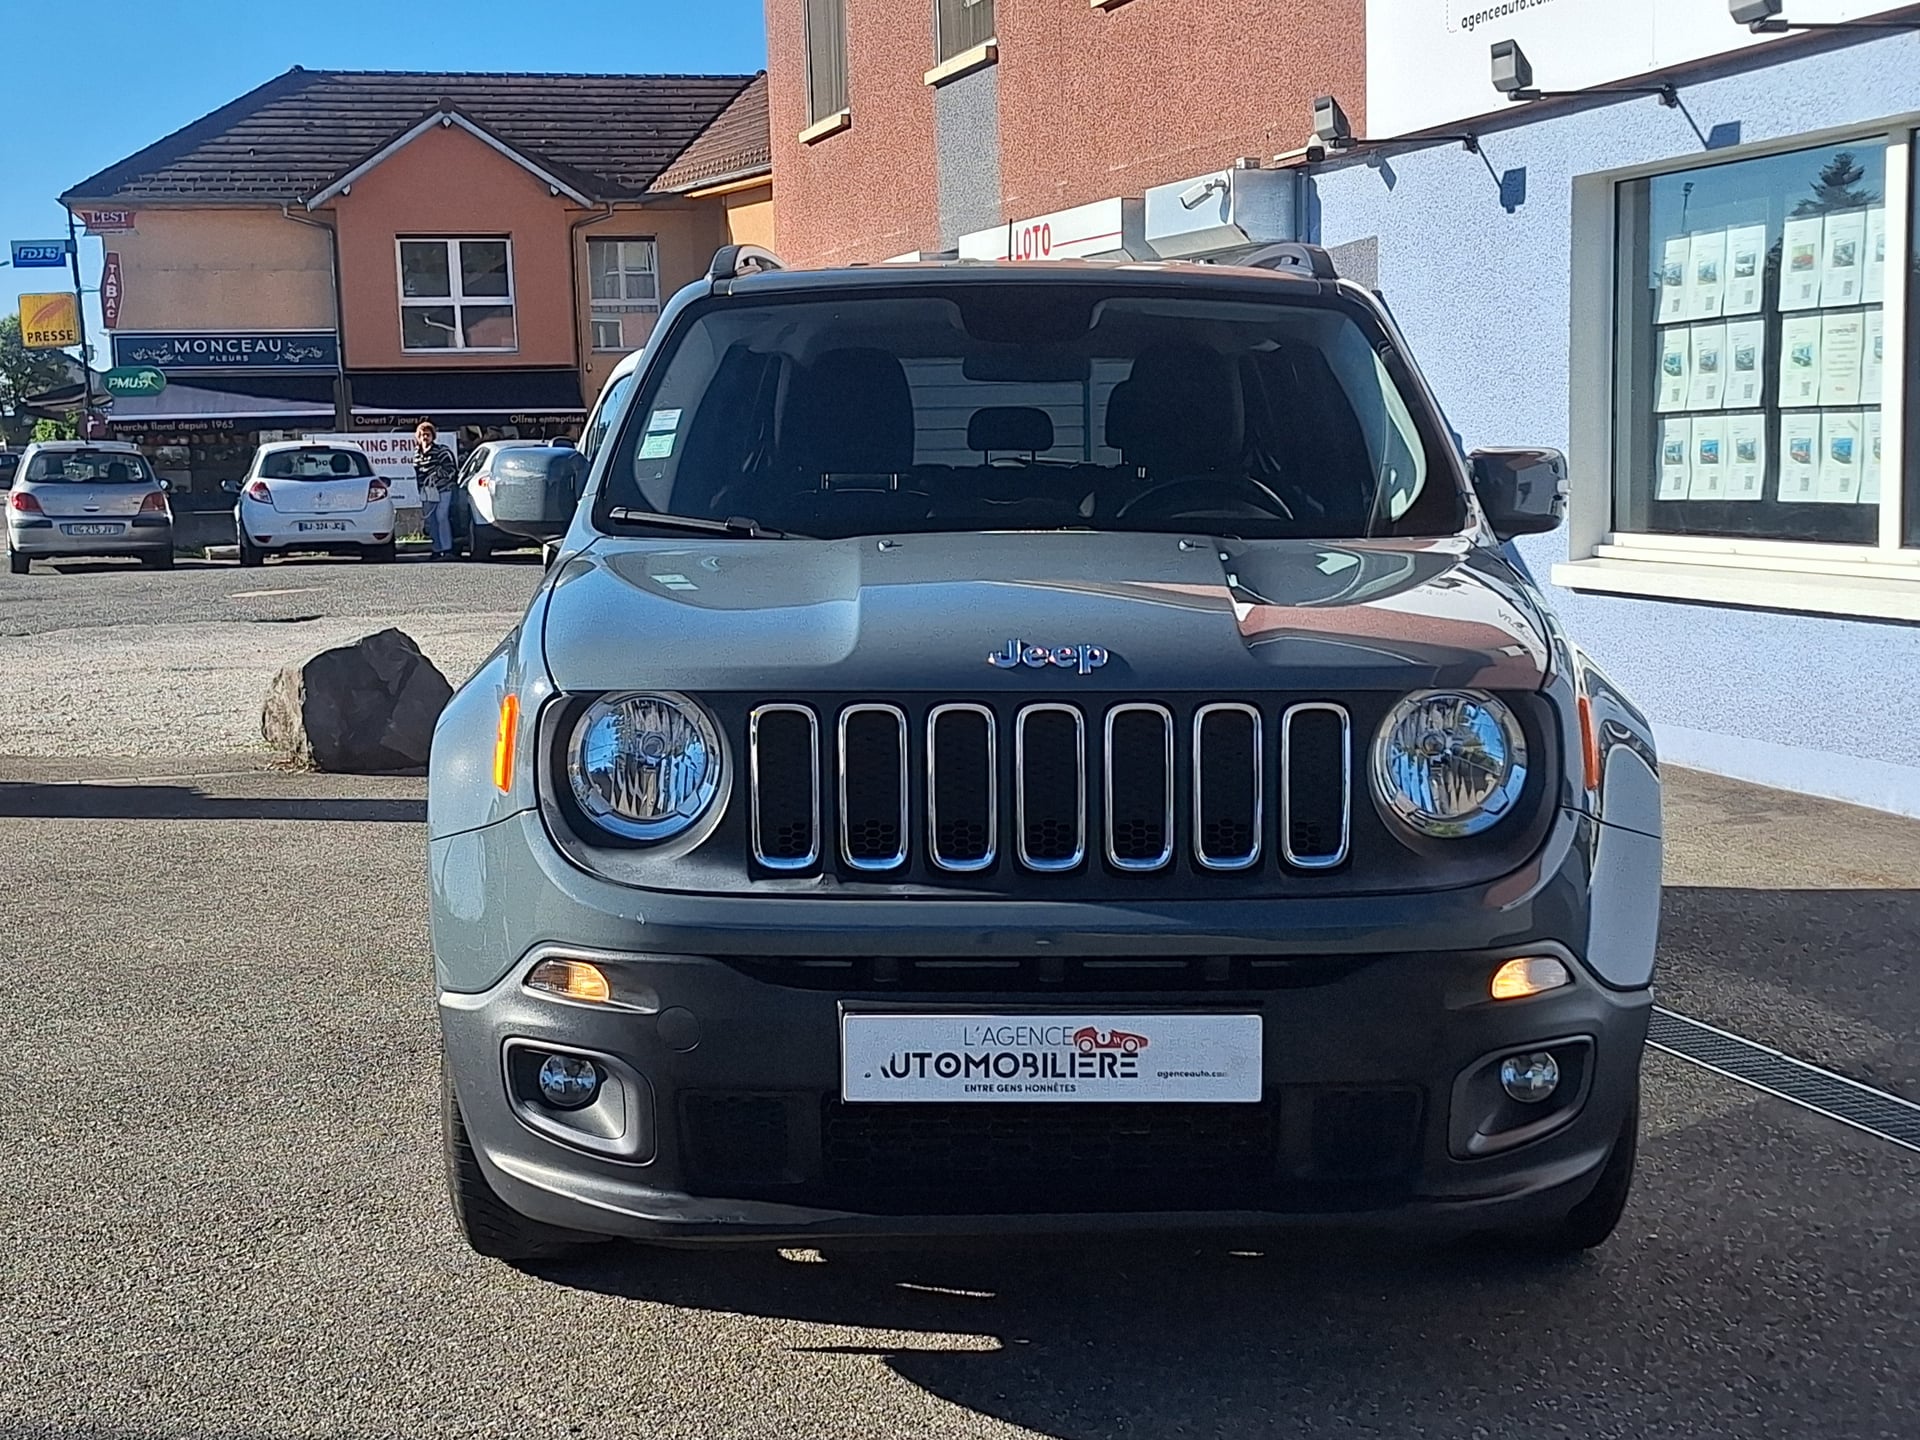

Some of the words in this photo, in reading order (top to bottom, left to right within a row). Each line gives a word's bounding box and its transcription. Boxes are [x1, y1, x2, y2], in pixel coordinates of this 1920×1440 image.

[1016, 222, 1051, 260] LOTO
[20, 248, 45, 259] FDJ
[106, 264, 118, 318] TABAC
[27, 329, 74, 343] PRESSE
[174, 339, 282, 353] MONCEAU
[108, 376, 139, 390] PMU
[211, 419, 235, 430] 1965
[987, 638, 1109, 675] Jeep
[964, 1026, 1074, 1047] L'AGENCE
[964, 1083, 995, 1093] ENTRE
[996, 1083, 1023, 1093] GENS
[1024, 1081, 1076, 1093] HONNÊTES
